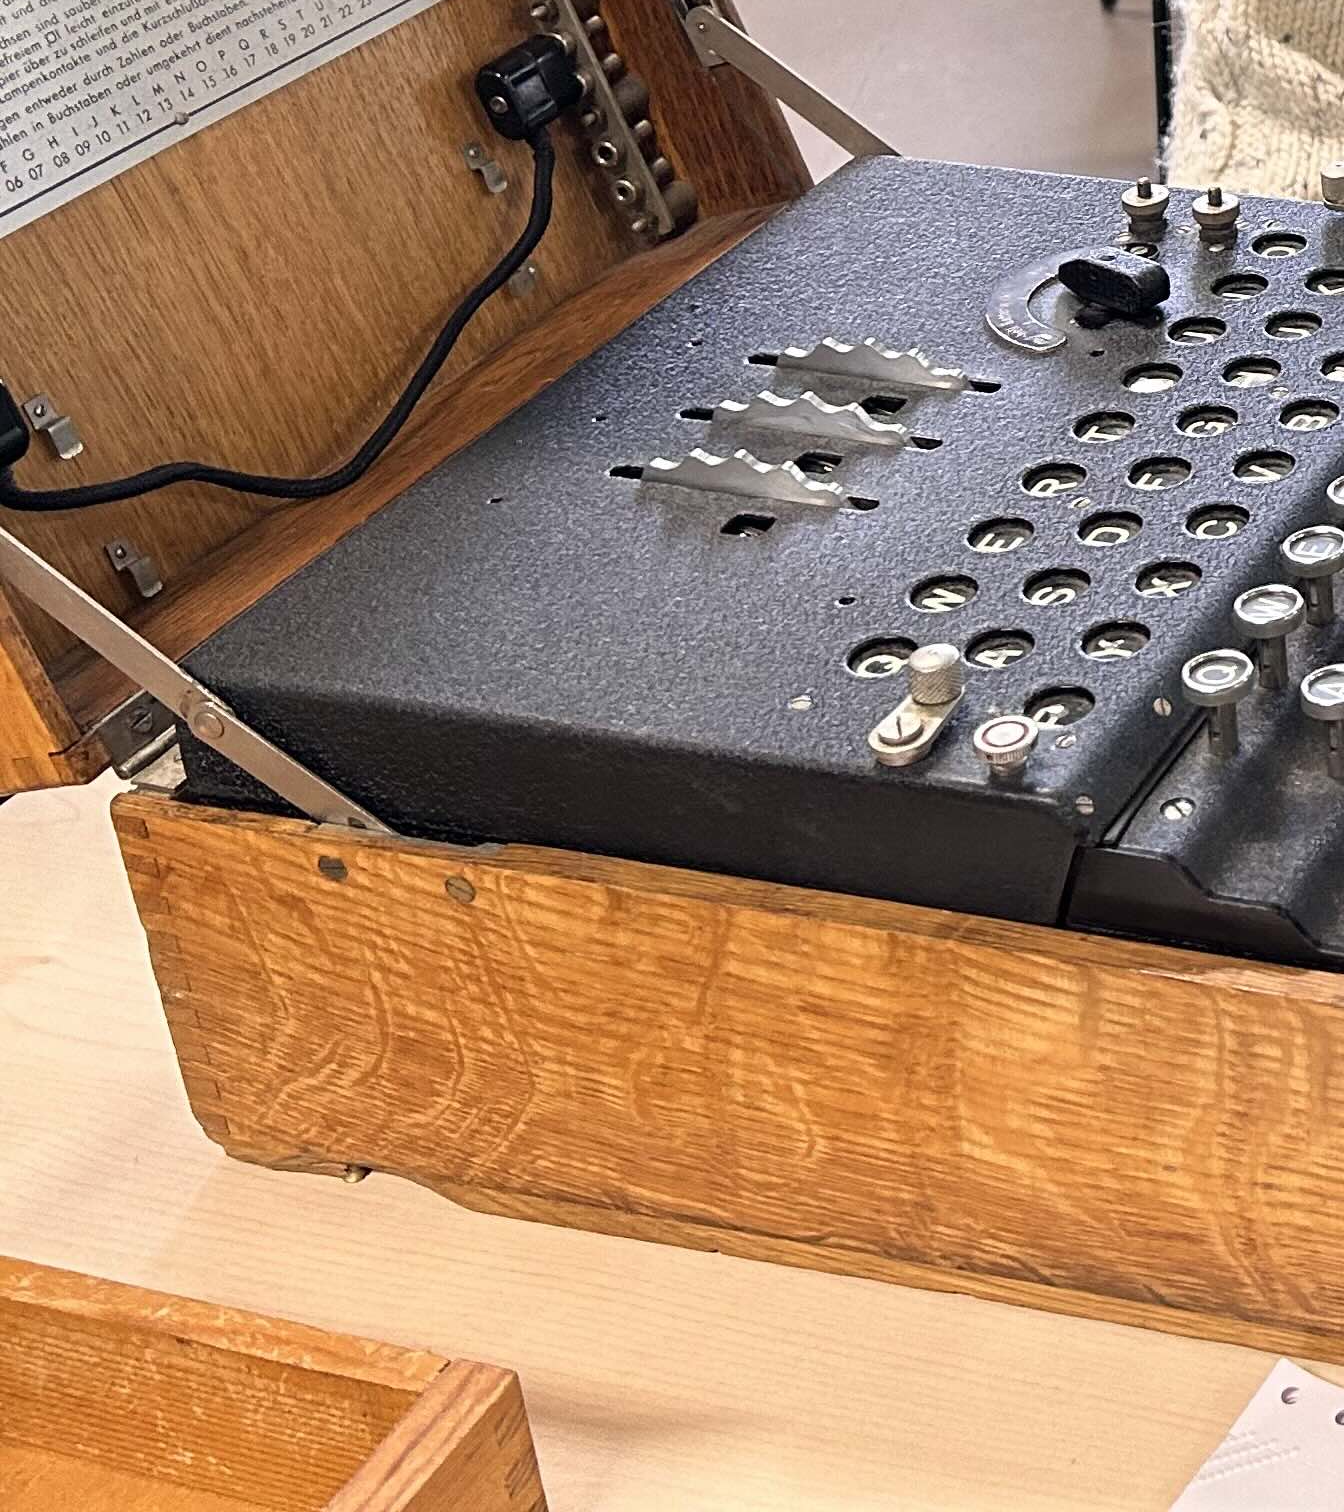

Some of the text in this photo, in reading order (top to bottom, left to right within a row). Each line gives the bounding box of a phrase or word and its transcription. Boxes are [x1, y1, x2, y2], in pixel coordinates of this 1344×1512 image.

[10, 0, 36, 20] und
[22, 7, 142, 74] über und
[34, 11, 61, 33] sind
[120, 29, 140, 45] die
[4, 174, 24, 193] 06
[27, 162, 44, 181] 07
[51, 150, 71, 169] 08
[73, 139, 91, 157] 09
[94, 129, 112, 146] 10
[115, 119, 131, 136] 11
[134, 107, 153, 125] 12
[156, 96, 174, 113] 13
[178, 86, 196, 102] 14
[200, 74, 217, 91] 15
[220, 63, 239, 80] 16
[242, 52, 256, 68] 17
[263, 41, 280, 57] 18
[282, 32, 296, 48] 19
[299, 22, 316, 39] 20
[318, 13, 334, 29] 21
[336, 2, 354, 20] 22
[21, 147, 36, 162] G
[45, 134, 60, 150] H
[108, 103, 123, 118] K
[130, 94, 142, 107] L
[151, 82, 165, 97] M
[172, 69, 187, 85] N
[194, 59, 208, 73] O
[216, 48, 226, 62] P
[237, 37, 251, 51] Q
[258, 27, 270, 41] R
[276, 17, 288, 31] S
[294, 8, 305, 21] T
[313, 0, 325, 12] U
[23, 29, 184, 115] entweder durch Zahlen oder
[29, 120, 45, 133] in
[45, 87, 113, 125] Buchstaben
[114, 71, 142, 91] oder
[145, 39, 202, 76] umgekehrt
[204, 24, 233, 46] dient
[977, 533, 1024, 553] E
[1030, 478, 1077, 497] R
[1195, 519, 1238, 539] C
[1030, 587, 1076, 606] S
[1083, 526, 1130, 546] D
[1195, 664, 1238, 685] Q
[1295, 540, 1335, 558] E
